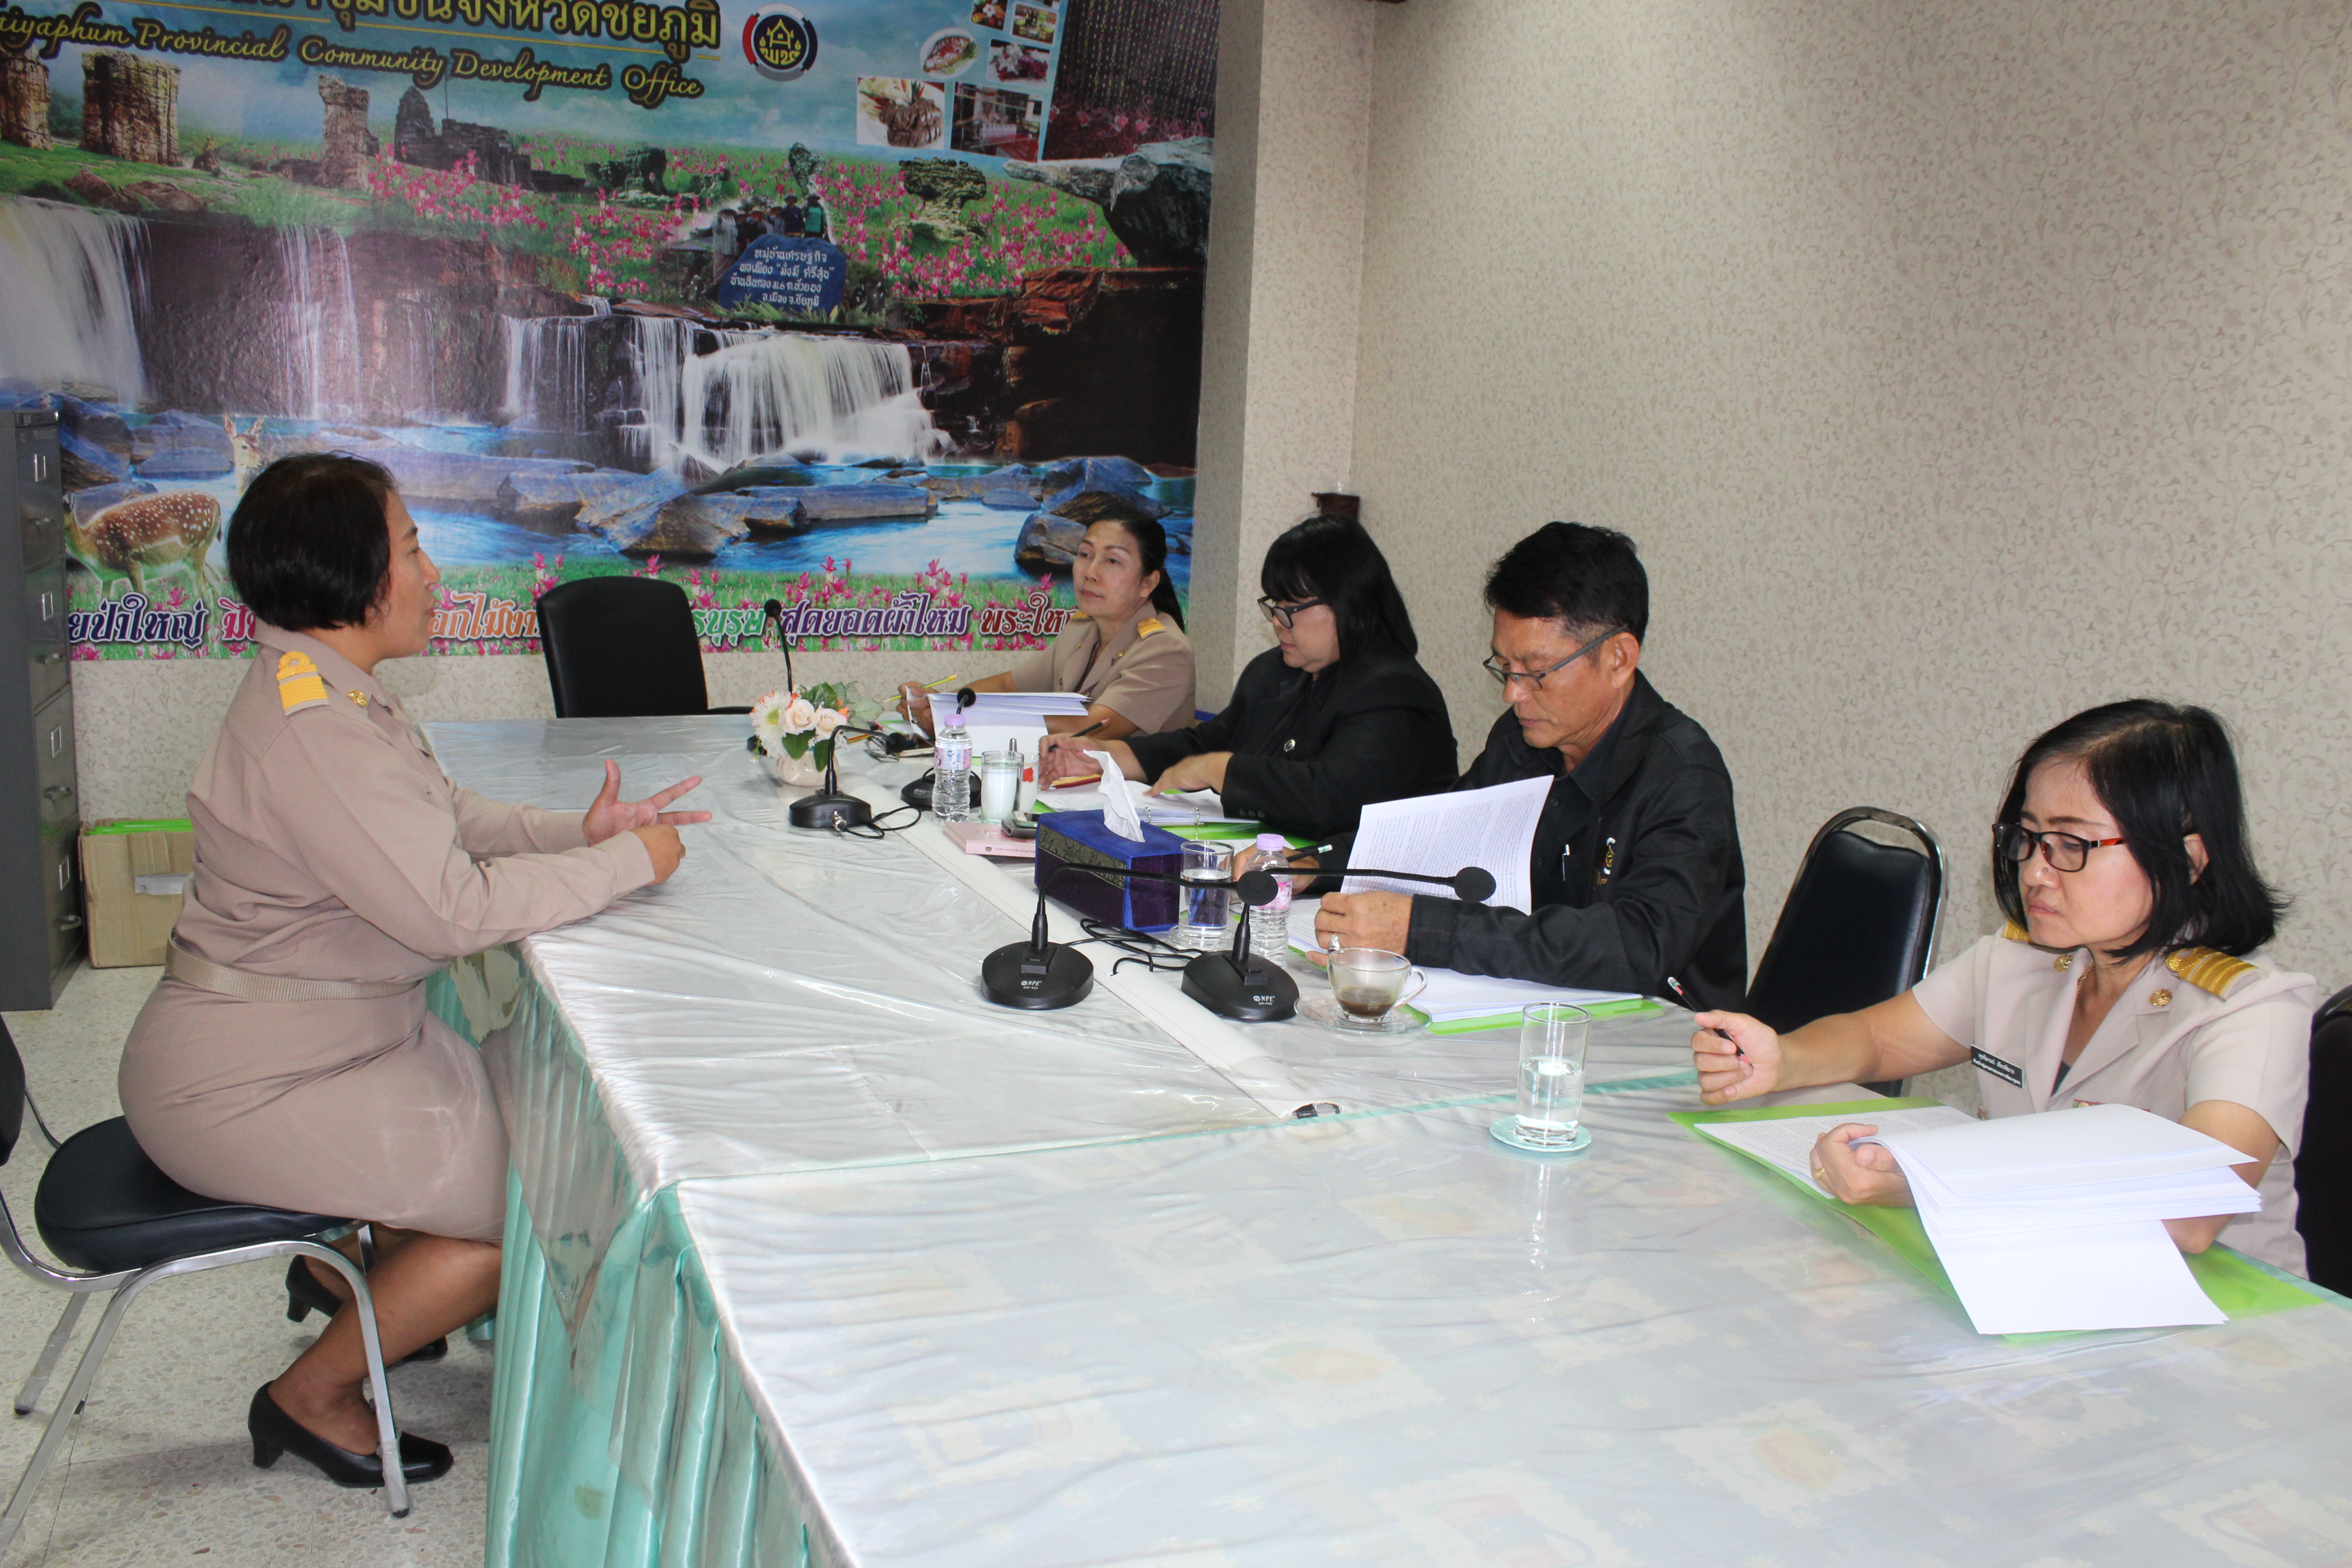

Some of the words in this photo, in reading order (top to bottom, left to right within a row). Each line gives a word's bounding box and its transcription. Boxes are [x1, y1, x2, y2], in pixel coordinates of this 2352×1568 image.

[137, 23, 285, 58] Provincial
[302, 39, 444, 85] Community
[454, 50, 608, 96] Development
[624, 64, 701, 105] Office
[780, 591, 972, 647] สุดยอดผ้าไหม
